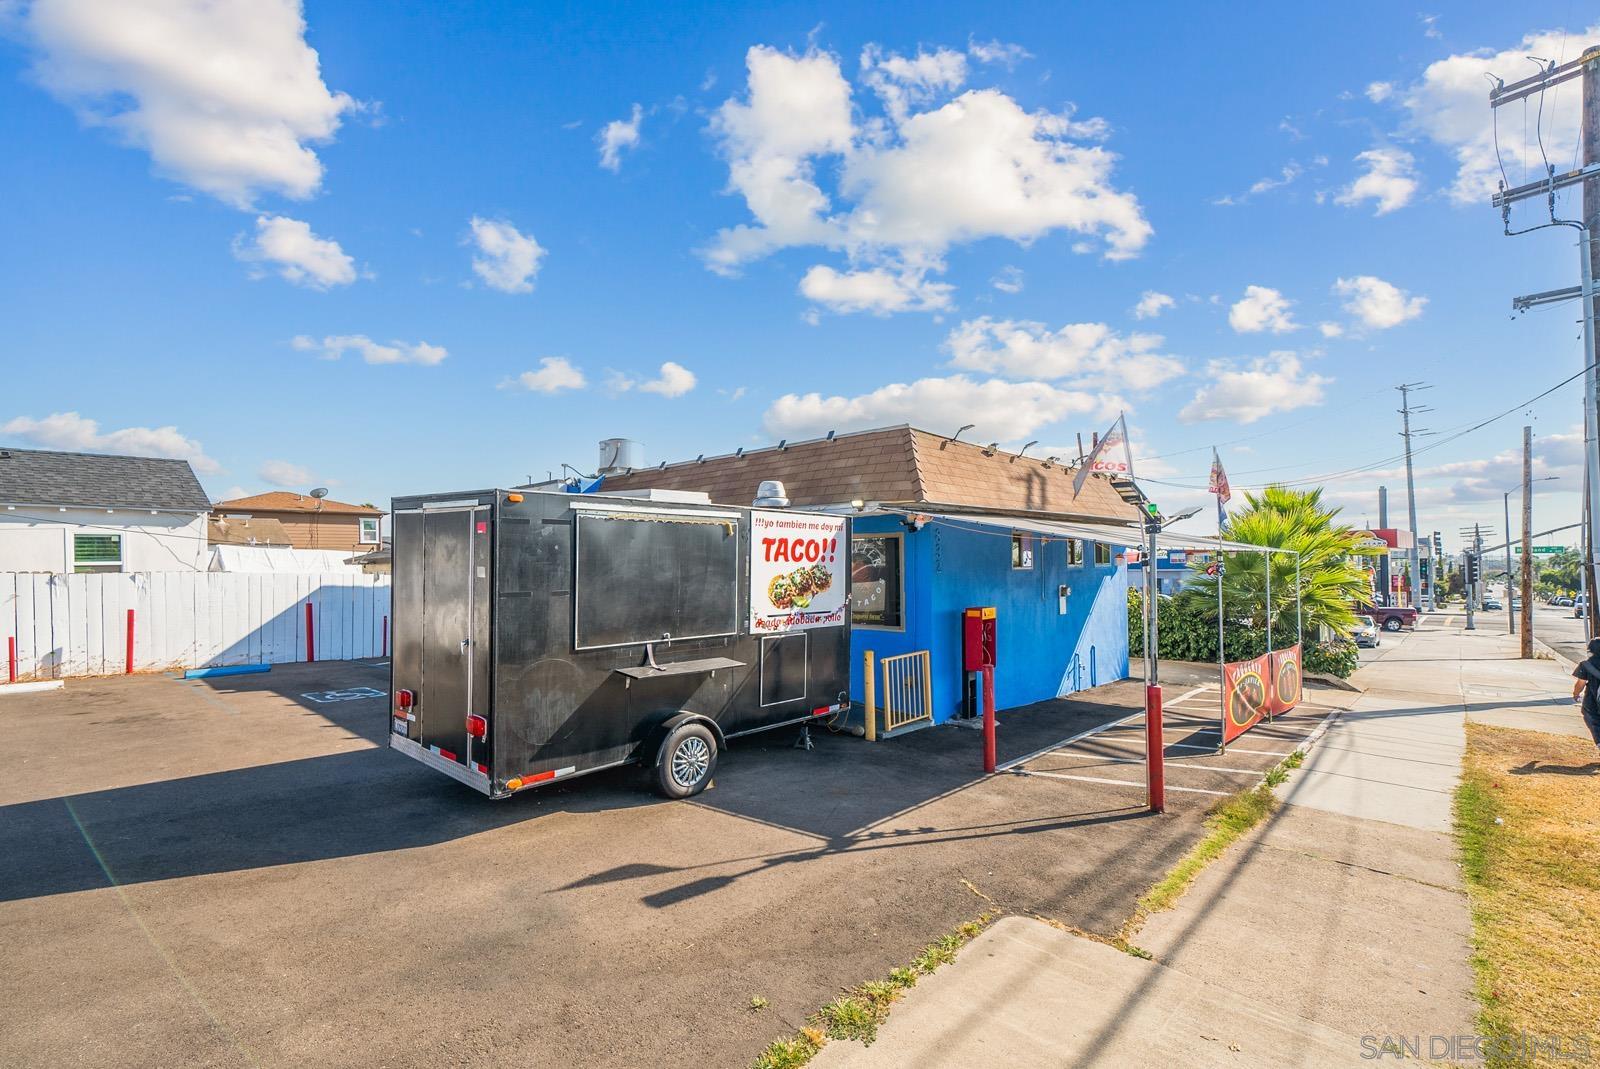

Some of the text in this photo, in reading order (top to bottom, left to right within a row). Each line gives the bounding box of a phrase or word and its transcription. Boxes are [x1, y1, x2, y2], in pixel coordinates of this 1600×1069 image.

[1091, 461, 1127, 471] COS
[776, 519, 807, 530] tambien
[808, 522, 819, 531] me
[761, 537, 837, 563] TACO!!
